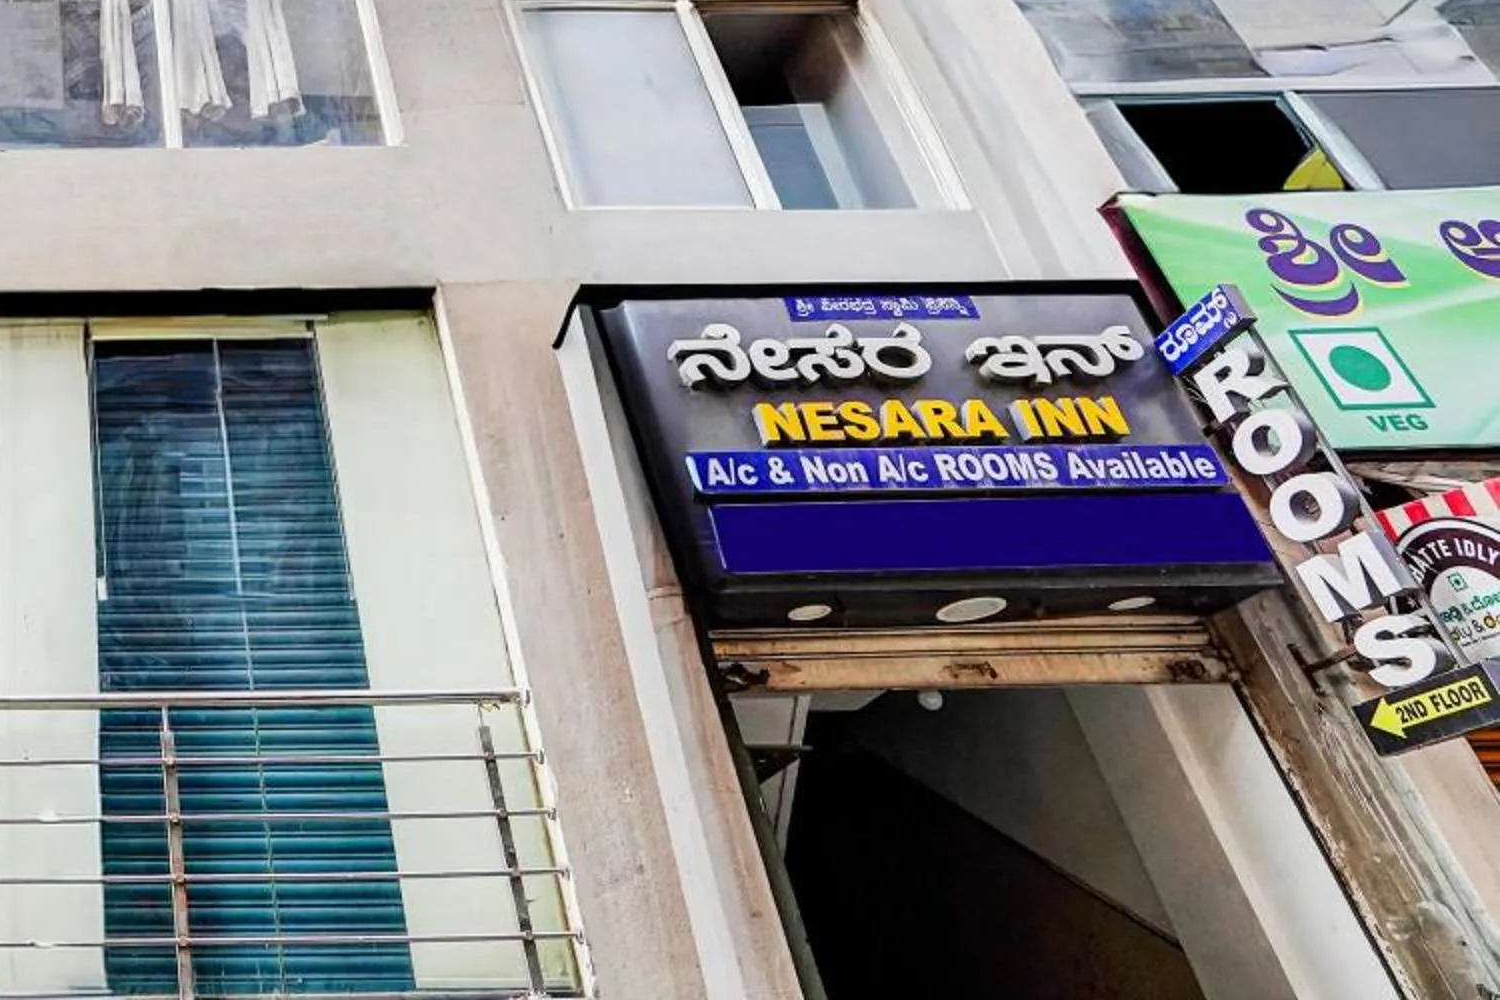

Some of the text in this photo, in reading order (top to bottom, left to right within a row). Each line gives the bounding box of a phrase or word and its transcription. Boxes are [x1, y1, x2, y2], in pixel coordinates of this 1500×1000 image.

[756, 397, 1131, 444] NESARA INN
[1366, 413, 1429, 433] VEG
[707, 450, 1217, 486] A/c & Non A/c ROOMS Available
[1194, 346, 1437, 688] ROOMS
[1453, 537, 1500, 566] IDLY
[1395, 681, 1487, 724] 2ND FLOOR
